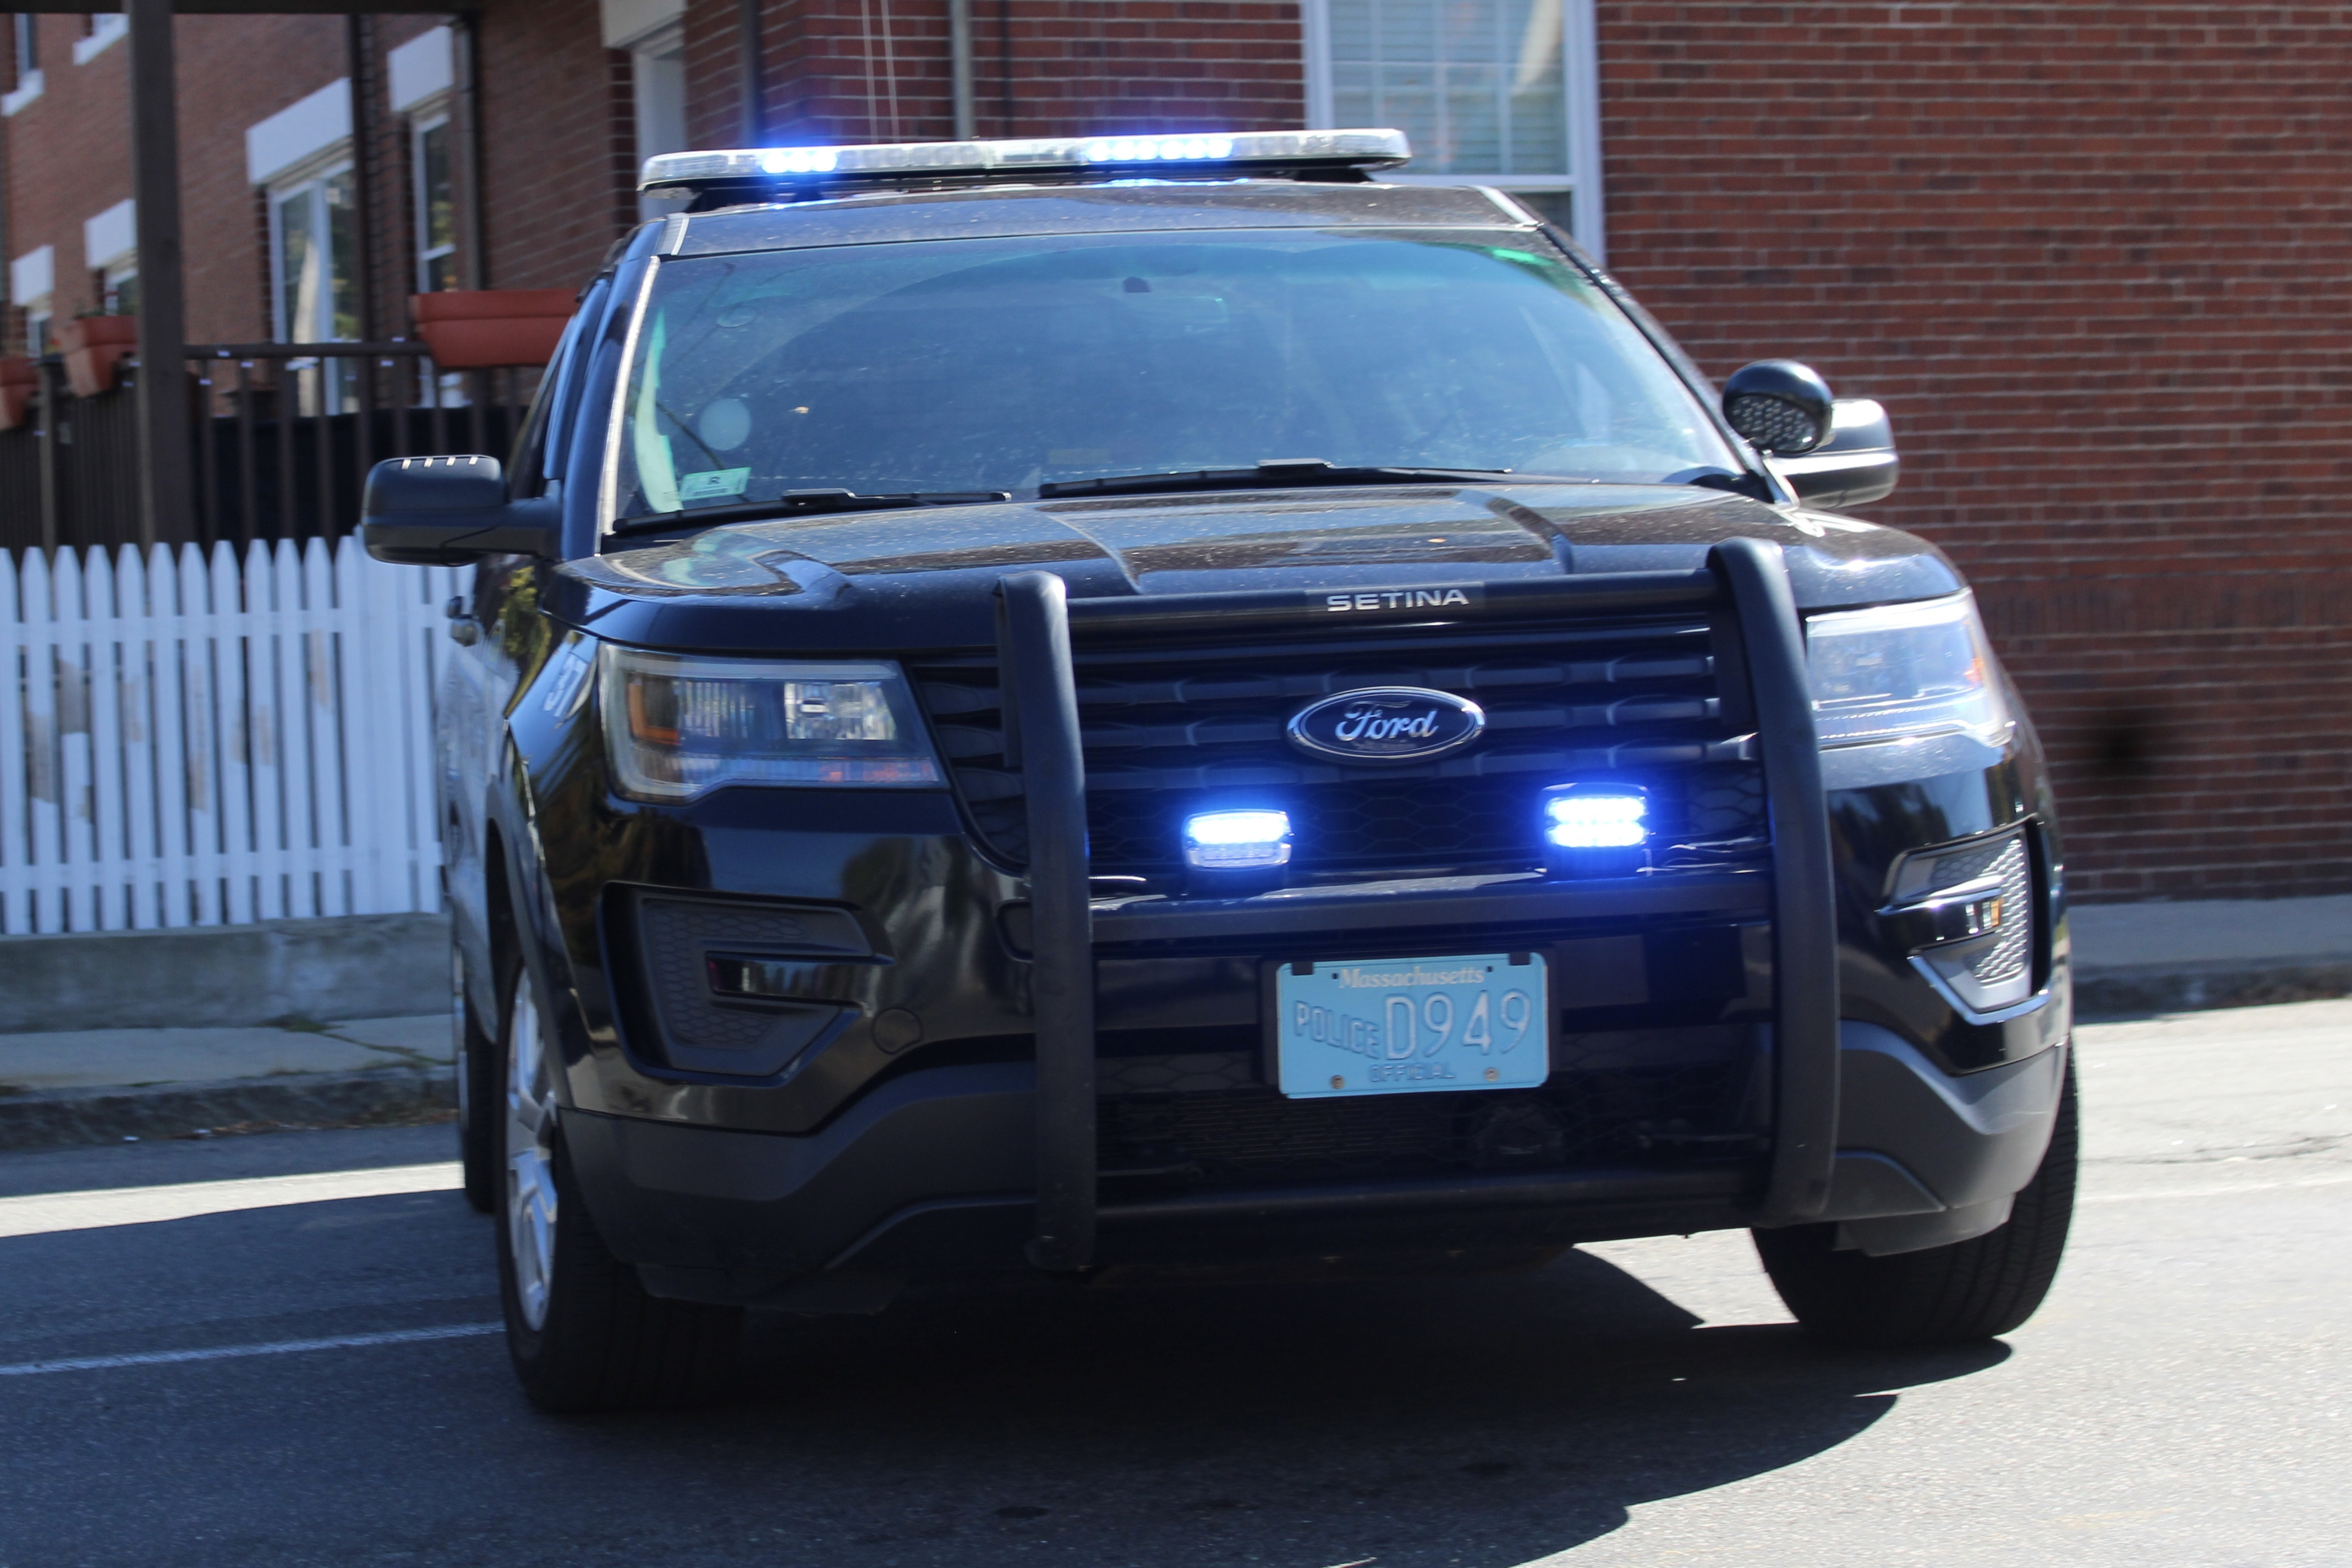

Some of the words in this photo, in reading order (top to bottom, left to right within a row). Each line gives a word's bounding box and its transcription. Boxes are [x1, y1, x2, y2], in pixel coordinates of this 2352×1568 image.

[1326, 589, 1470, 612] SETINA
[1335, 700, 1440, 741] Ford
[1338, 967, 1485, 988] Massachusetts
[1294, 1000, 1380, 1060] POLICE
[1384, 988, 1532, 1060] D949
[1369, 1062, 1456, 1082] OFFICIAL
